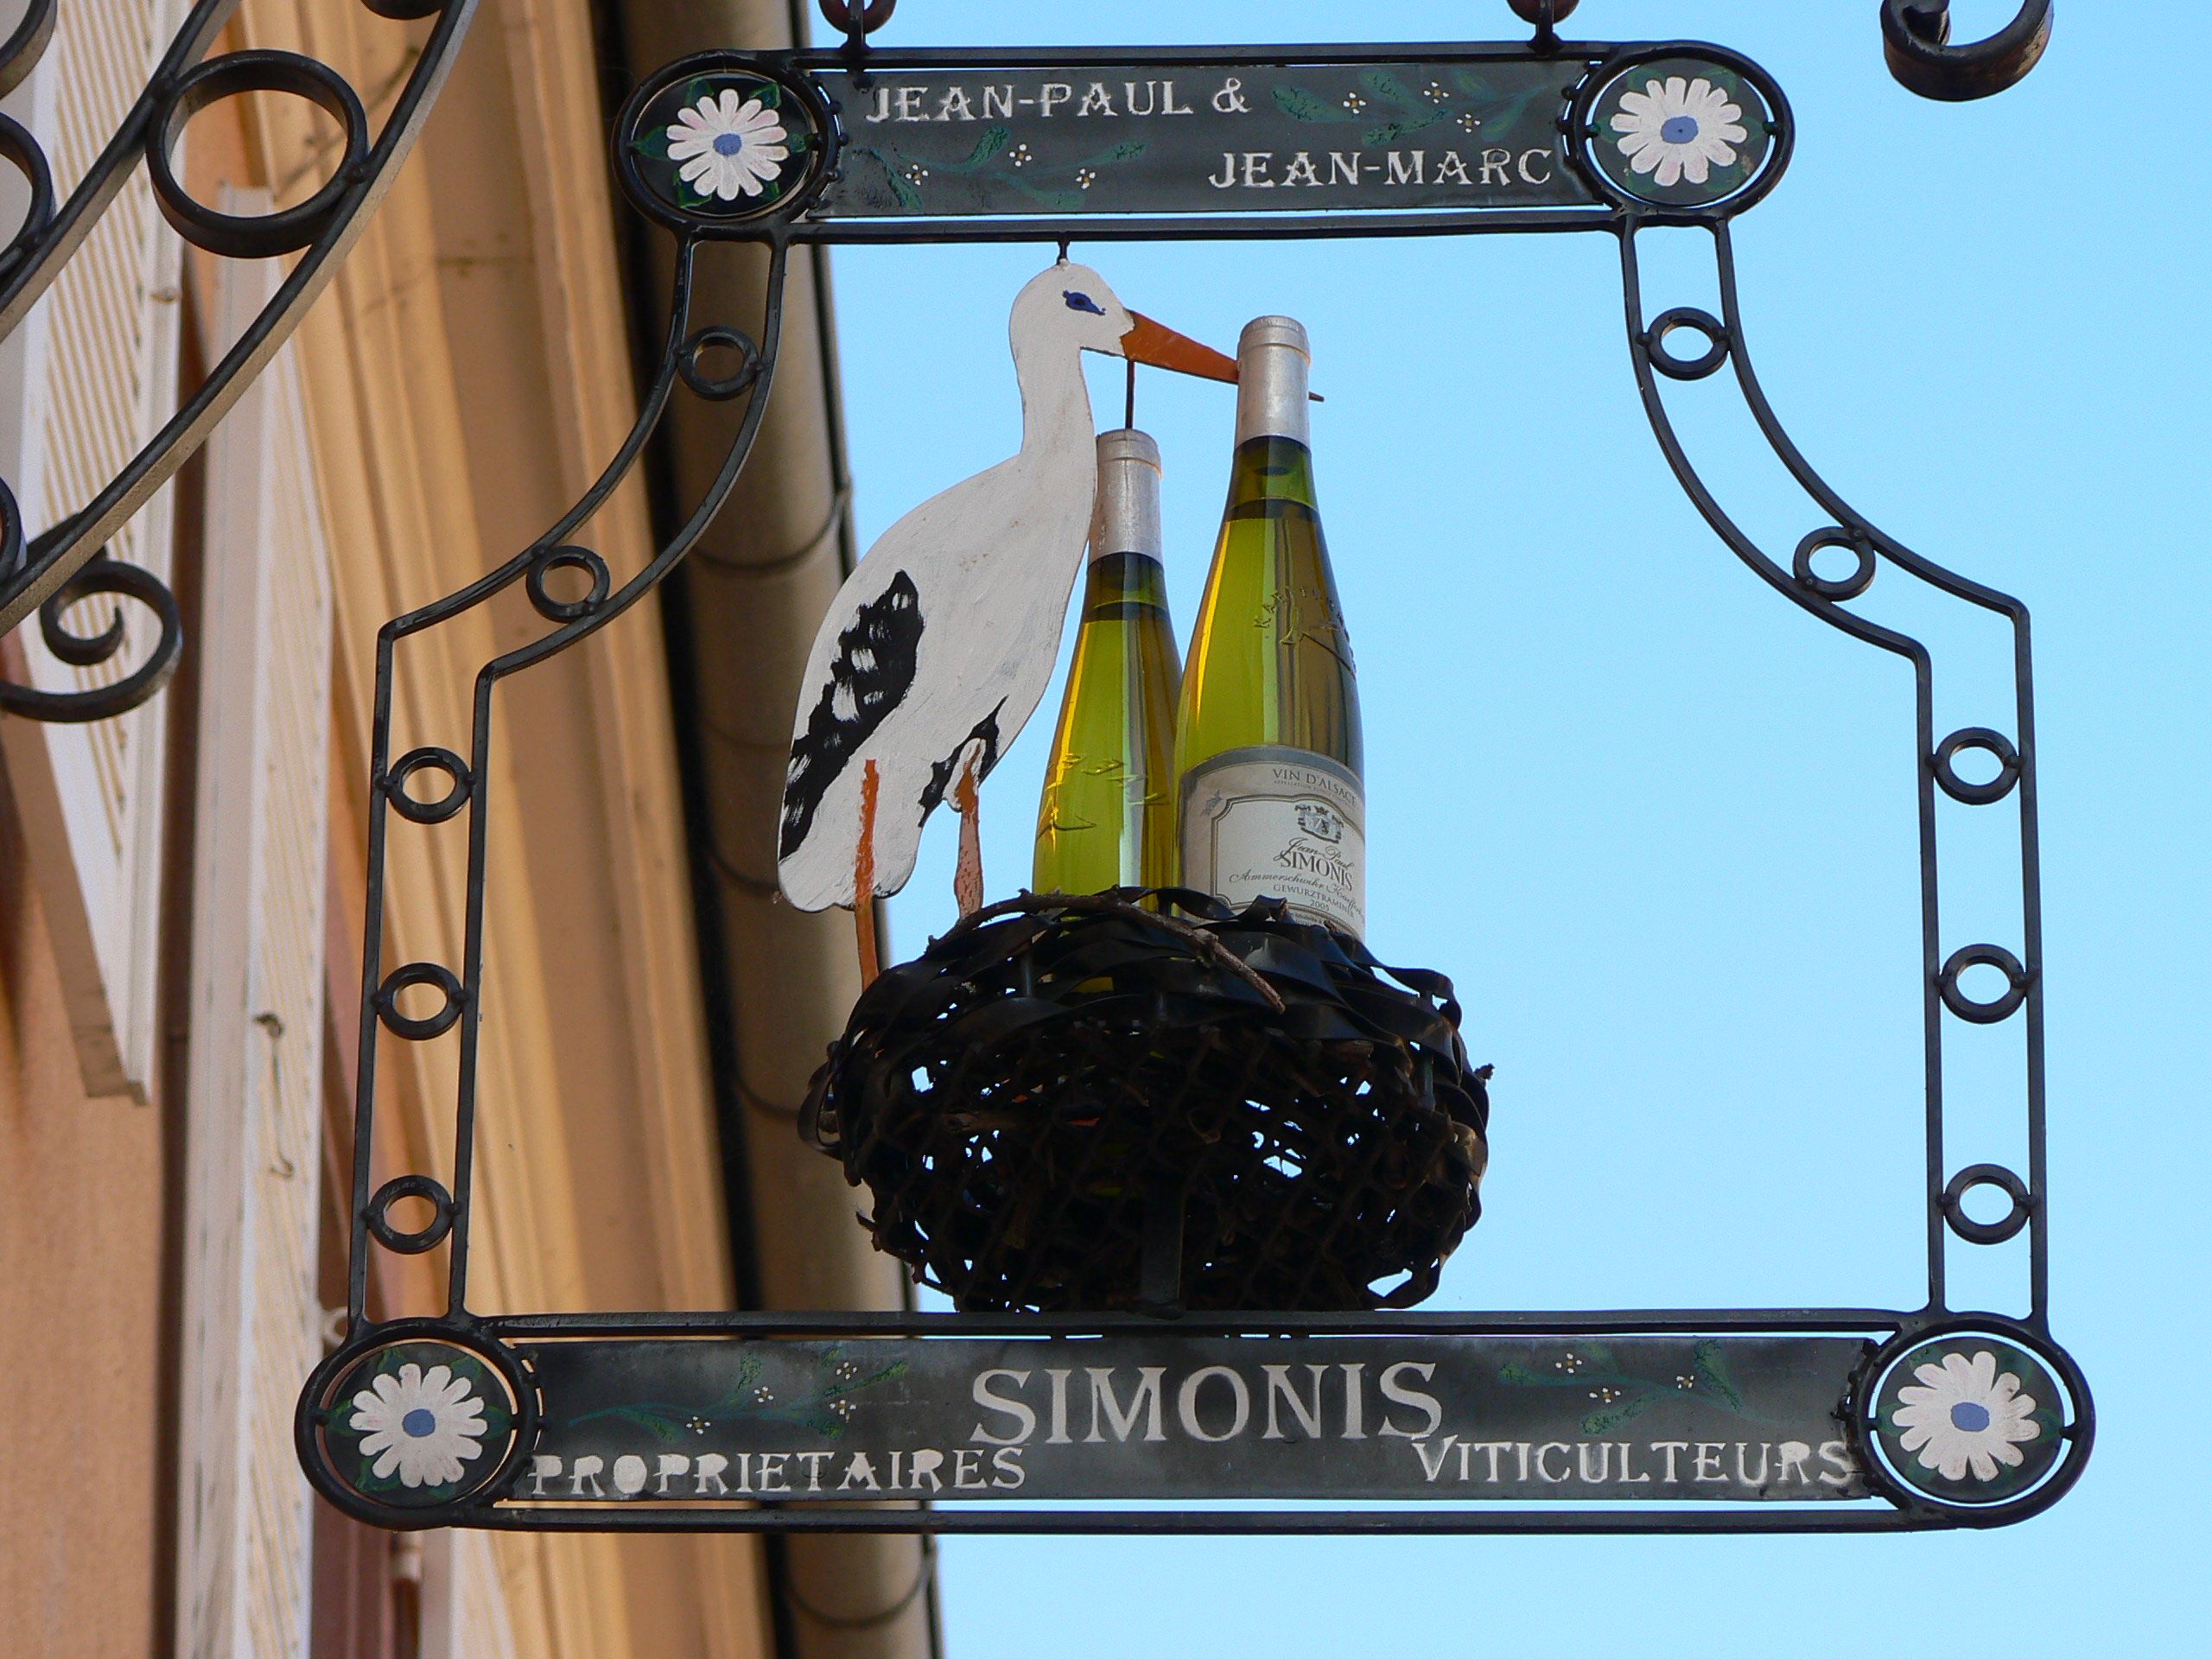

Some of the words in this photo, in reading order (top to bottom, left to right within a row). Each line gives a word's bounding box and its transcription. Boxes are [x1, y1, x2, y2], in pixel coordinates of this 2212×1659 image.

[865, 79, 1193, 124] JEAN-PAUL
[1212, 77, 1251, 114] &
[1210, 147, 1553, 189] JEAN-MARC
[1273, 768, 1300, 781] VIN
[1280, 849, 1354, 891] SIMONIS
[969, 1360, 1443, 1445] SIMONIS
[527, 1447, 1026, 1498] PROPRIETAIRES
[1411, 1434, 1857, 1484] VITICULTEURS
